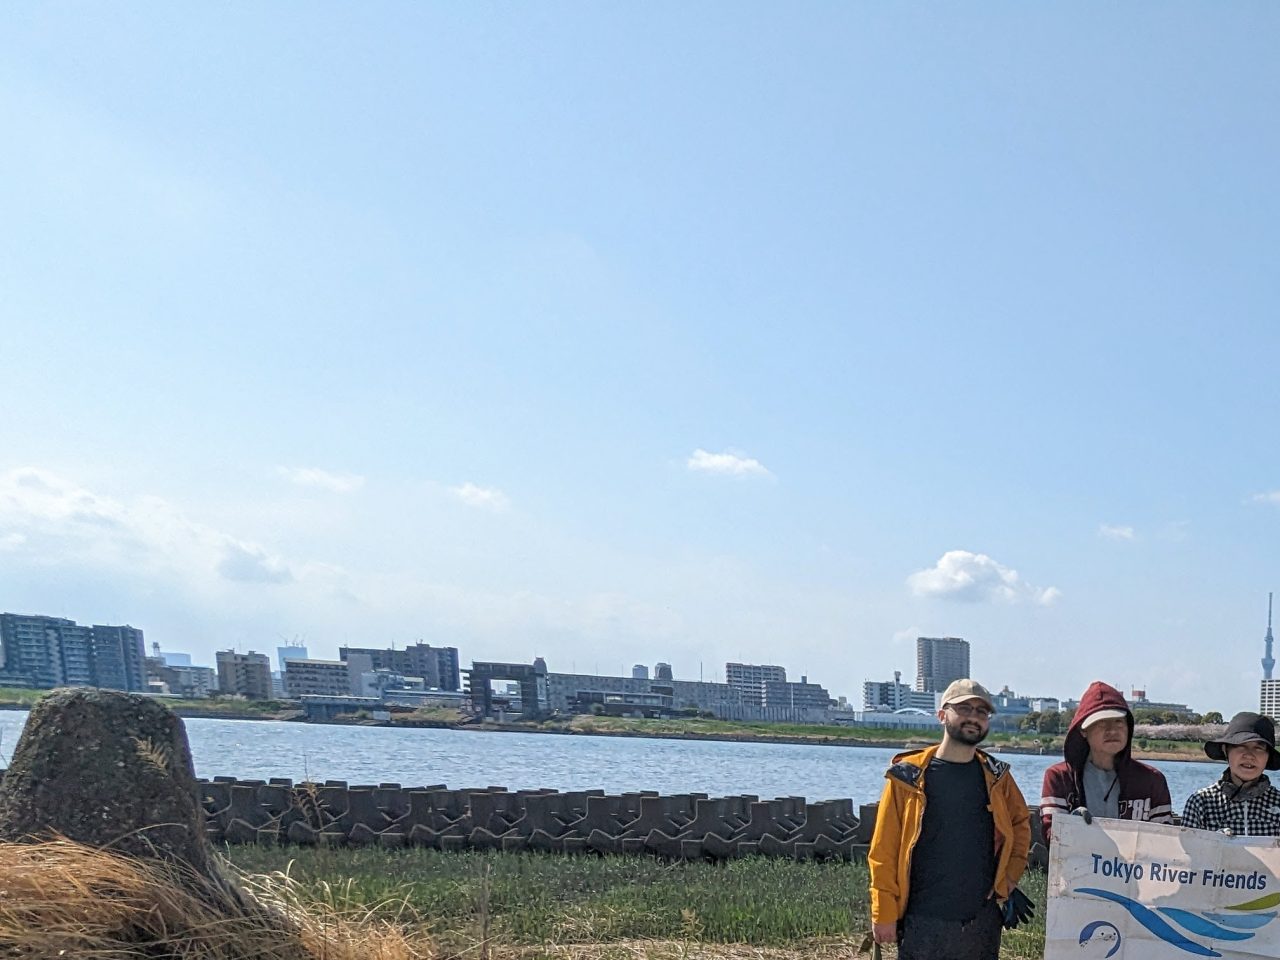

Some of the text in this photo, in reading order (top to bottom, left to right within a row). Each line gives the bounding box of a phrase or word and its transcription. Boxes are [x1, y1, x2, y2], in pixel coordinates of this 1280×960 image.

[1091, 853, 1267, 891] Tokyo River Friends
